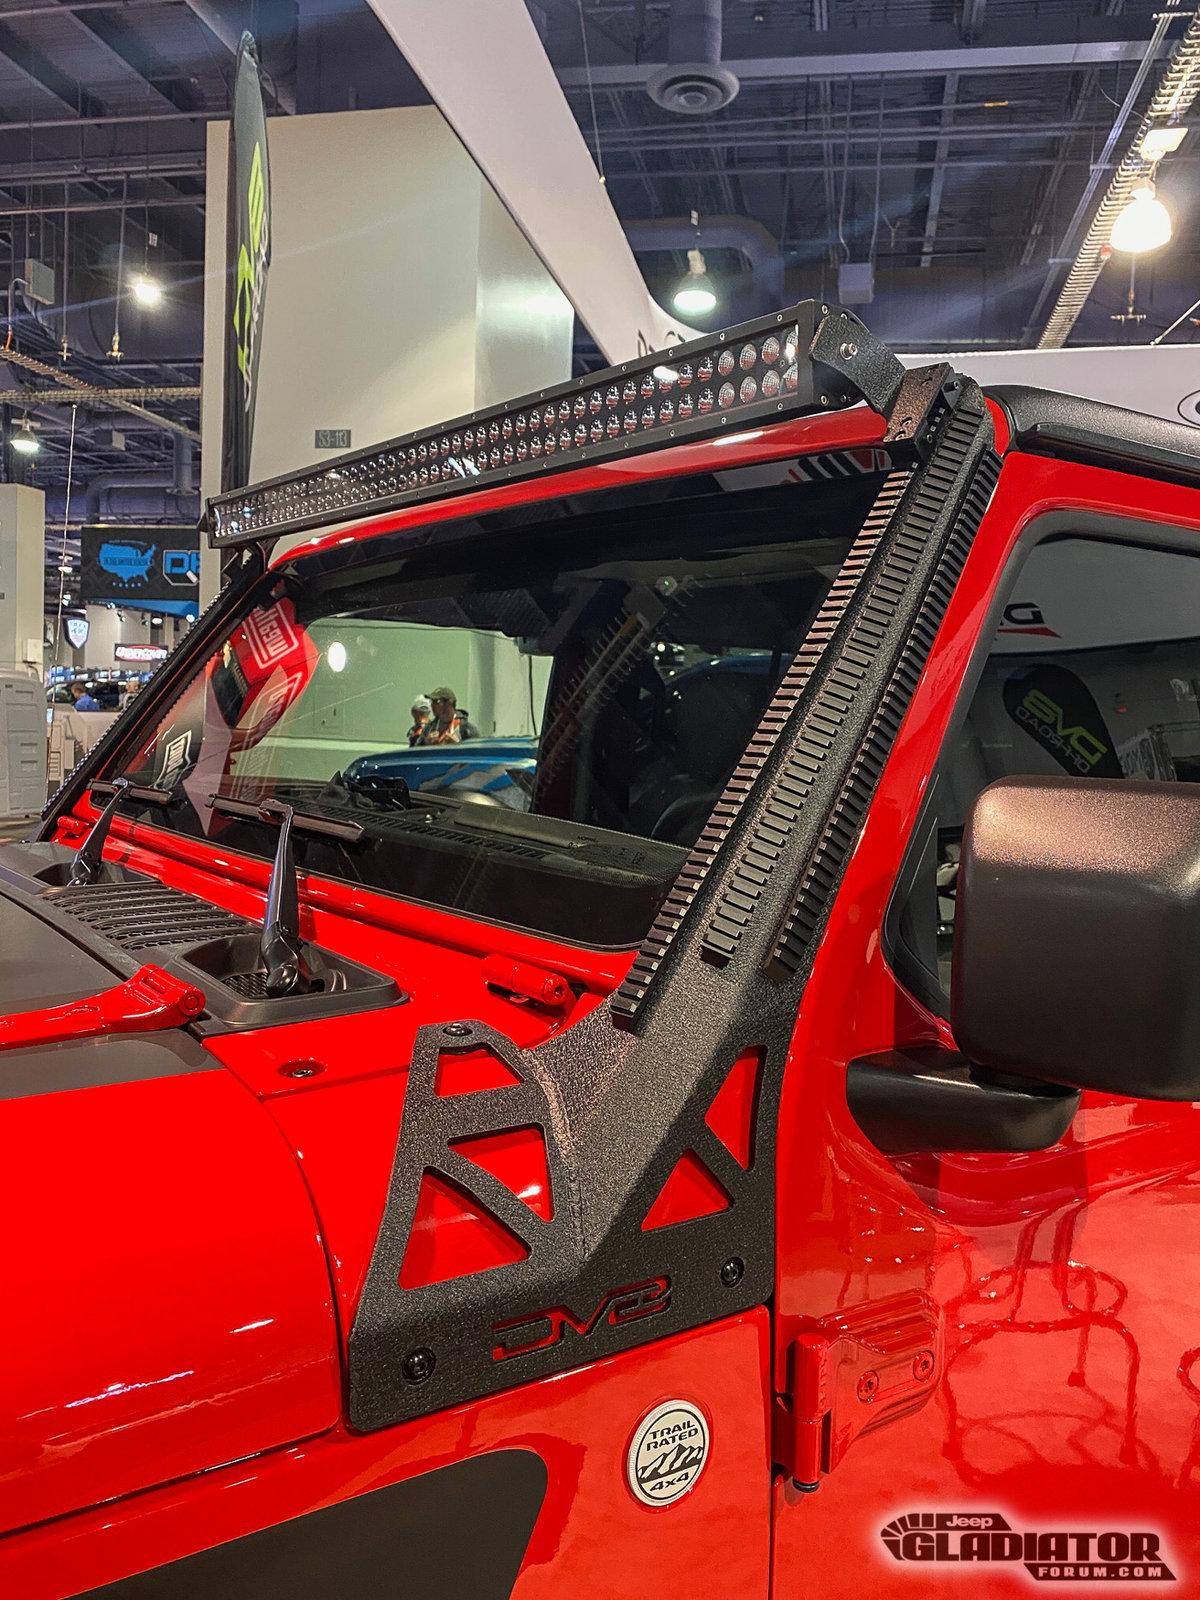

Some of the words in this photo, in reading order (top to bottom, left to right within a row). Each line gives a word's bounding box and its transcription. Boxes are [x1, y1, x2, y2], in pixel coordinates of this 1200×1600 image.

[646, 1427, 699, 1451] RATED
[649, 1420, 696, 1440] TRAIL
[649, 1471, 690, 1492] 4x4
